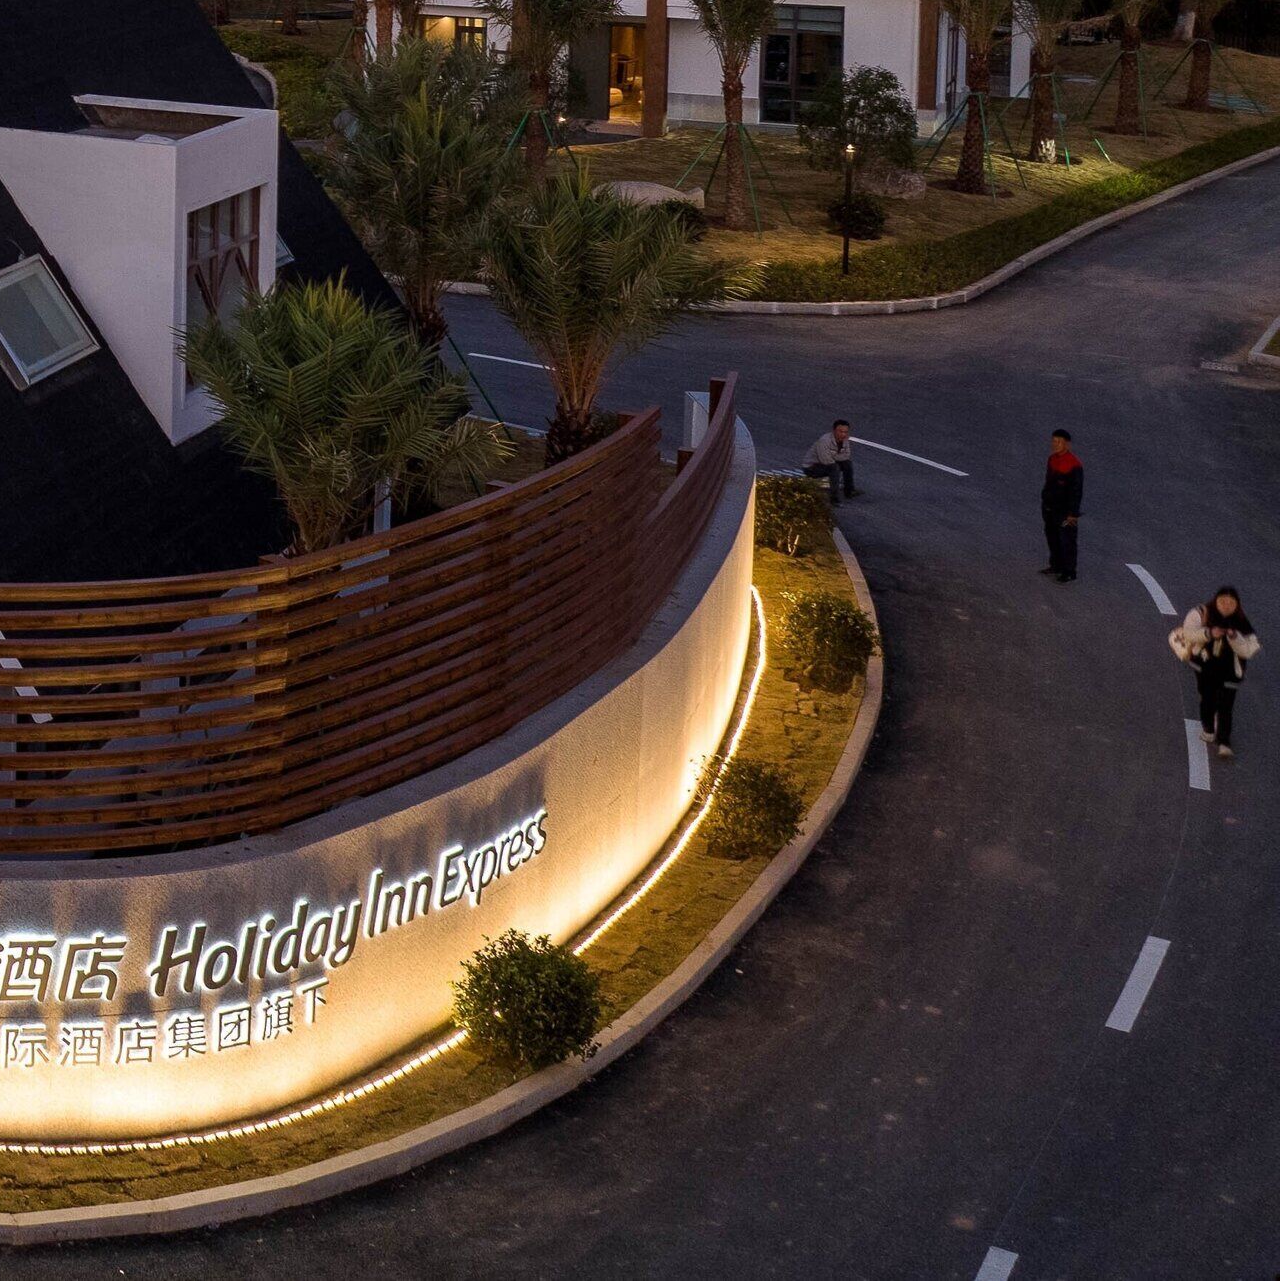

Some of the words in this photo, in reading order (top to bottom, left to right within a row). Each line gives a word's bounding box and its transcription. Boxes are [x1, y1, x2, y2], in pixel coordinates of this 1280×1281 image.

[148, 899, 363, 997] Holiday
[366, 868, 433, 938] Inn
[439, 809, 549, 906] Express
